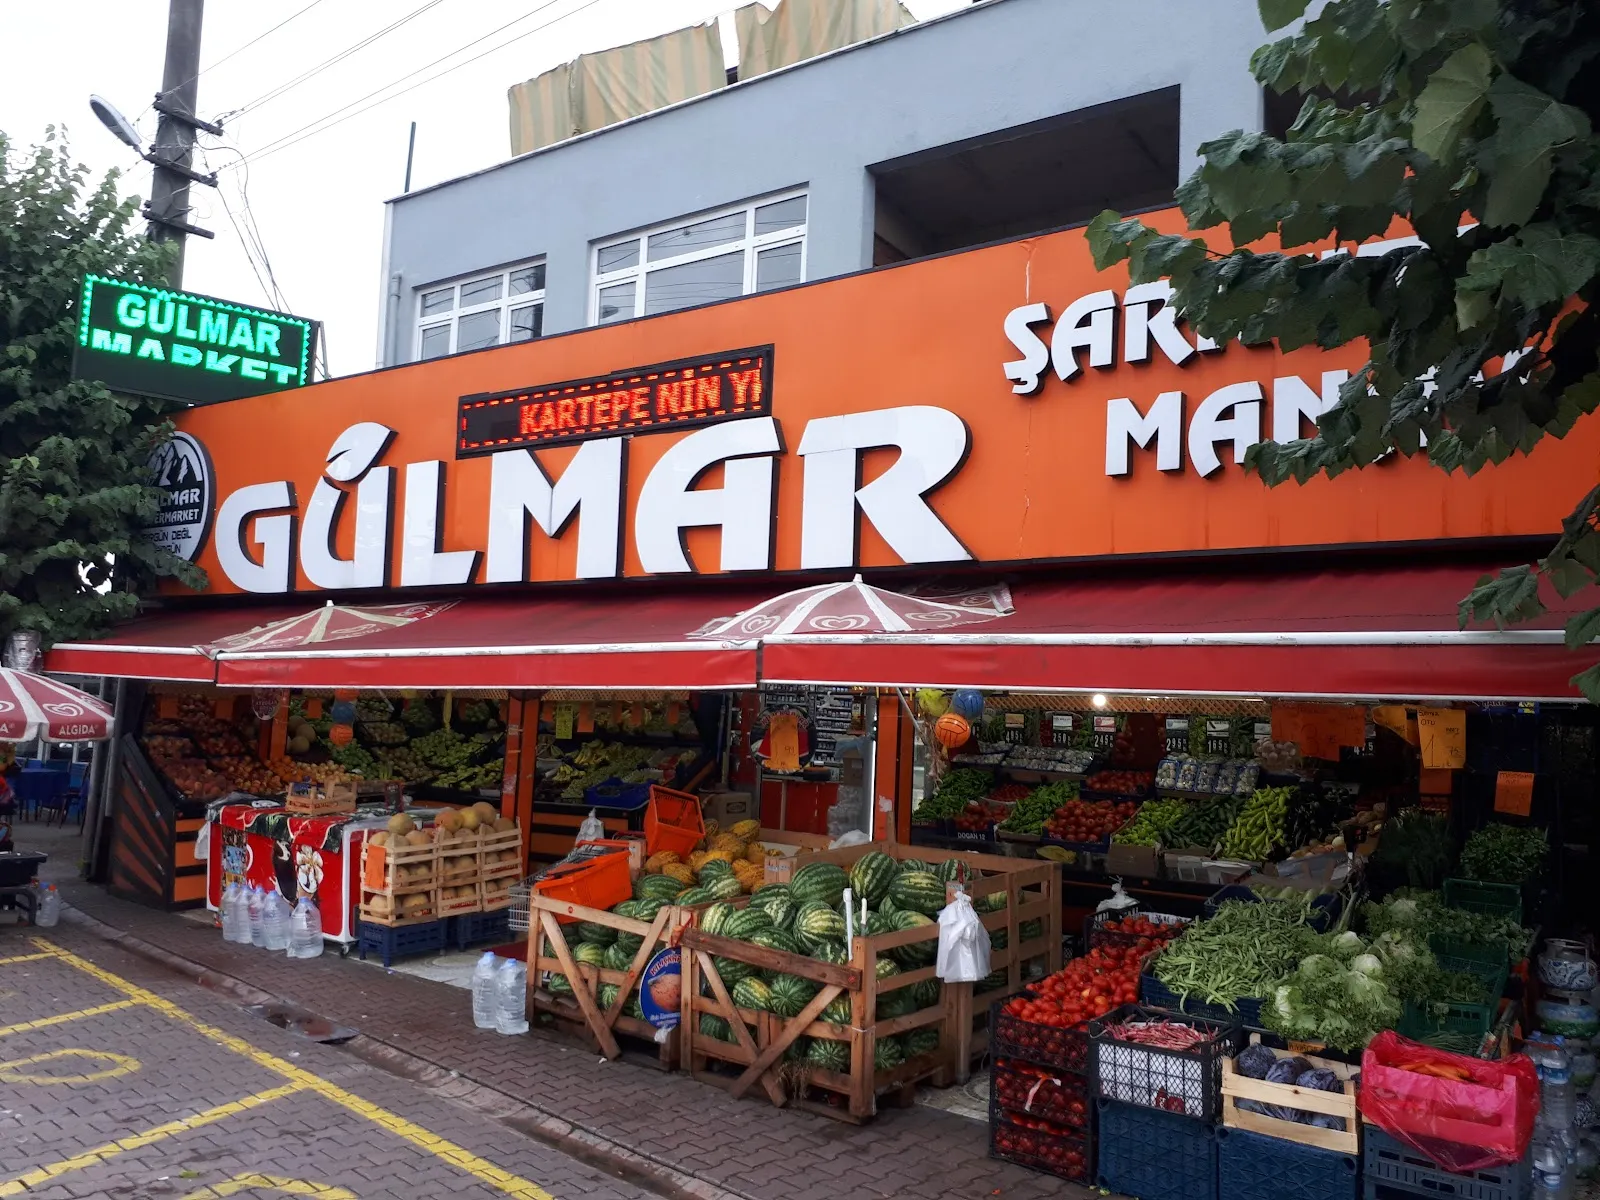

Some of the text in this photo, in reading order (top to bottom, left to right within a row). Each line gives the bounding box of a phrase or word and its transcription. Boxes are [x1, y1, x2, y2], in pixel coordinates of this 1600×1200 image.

[117, 290, 281, 356] GÜLMAR
[520, 387, 650, 434] KARTEPE
[656, 369, 721, 416] NİN
[154, 508, 200, 524] ERMARKET
[159, 488, 201, 507] LMAR
[214, 406, 975, 593] GÜLMAR
[59, 724, 95, 735] ALGIDA
